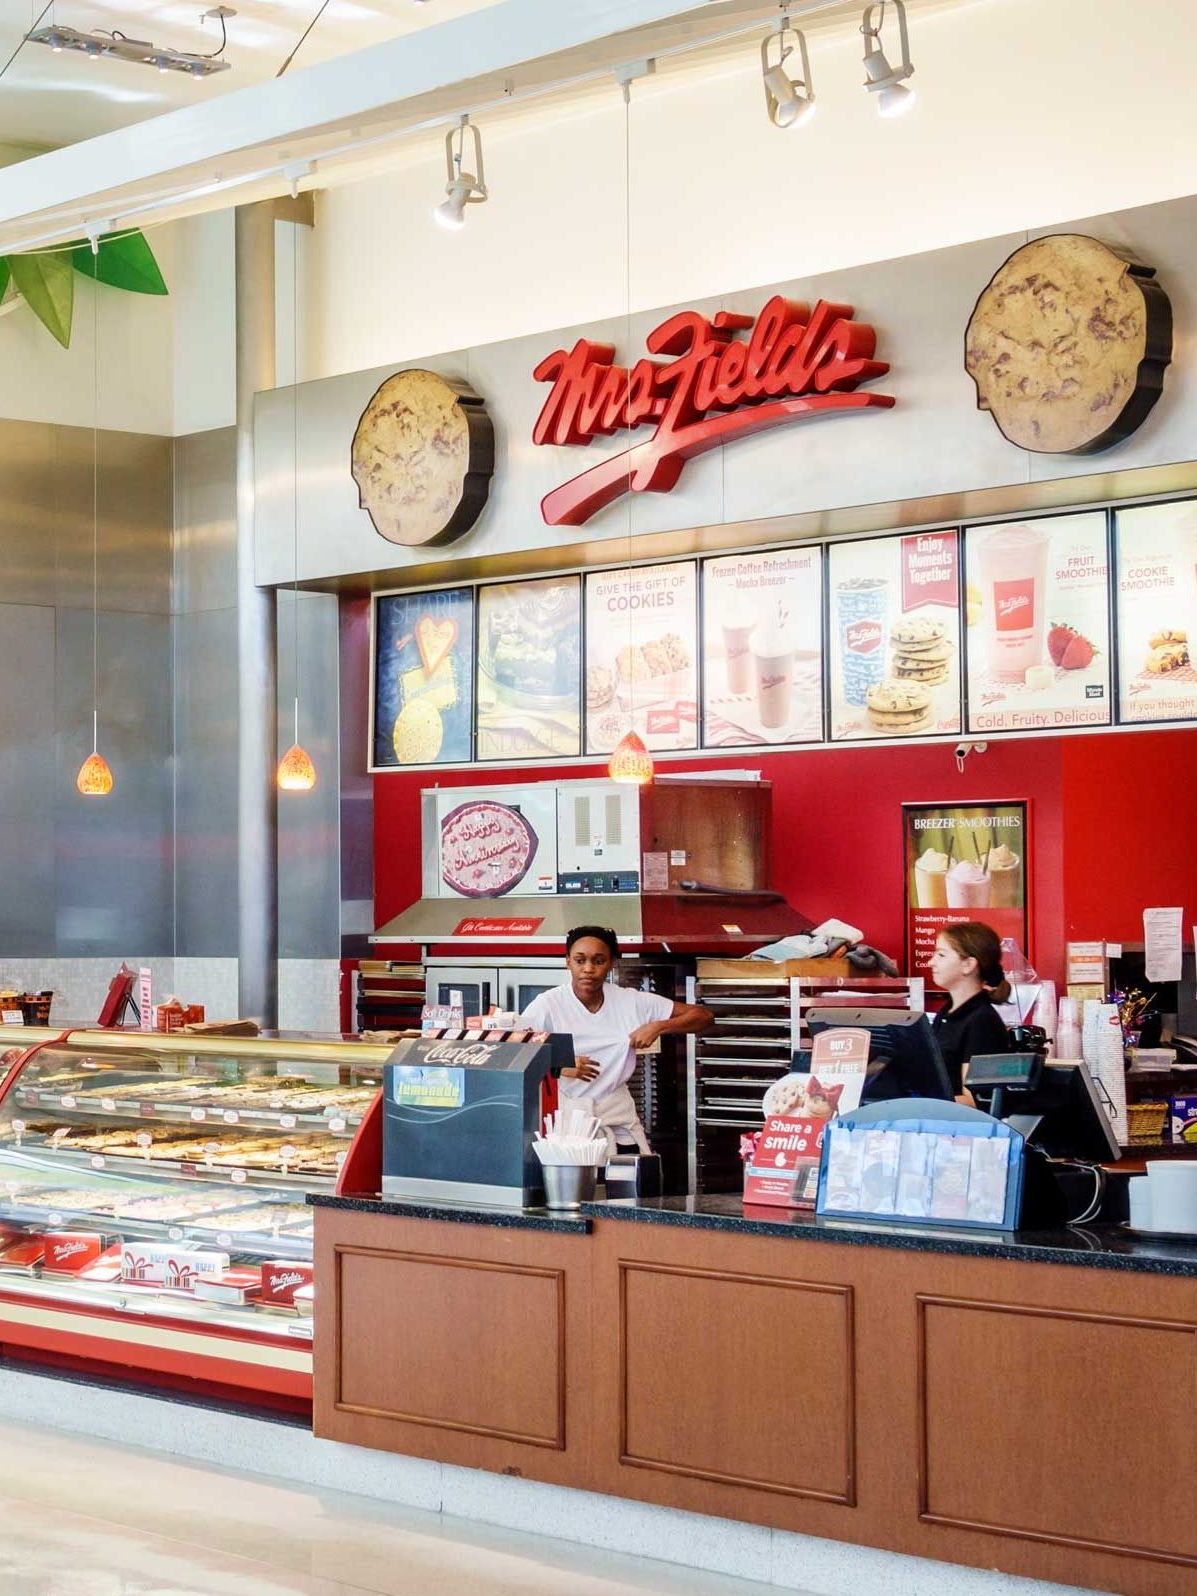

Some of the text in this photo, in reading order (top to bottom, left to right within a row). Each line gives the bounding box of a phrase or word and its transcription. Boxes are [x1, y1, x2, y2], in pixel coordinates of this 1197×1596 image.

[916, 536, 943, 554] Enjoy
[711, 555, 812, 578] Frozen Coffee Refreshment
[908, 552, 953, 569] Moments
[1067, 556, 1095, 567] FRUIT
[909, 567, 952, 585] Together
[1127, 565, 1169, 579] COOKIE
[596, 575, 686, 596] GIVE THE GIFT OF
[735, 577, 759, 589] Mocha
[1120, 576, 1175, 592] SMOOTHIE
[391, 590, 460, 625] SHARE
[607, 590, 675, 612] COOKIES
[1129, 698, 1195, 713] If you thought
[976, 714, 1007, 728] Cold.
[1011, 711, 1050, 728] Fruity.
[479, 727, 561, 753] INDULGE
[459, 819, 501, 840] Happy
[914, 815, 1021, 830] BREEZER SMOOTHIES
[915, 914, 970, 924] Strawberry-Banana
[915, 927, 936, 936] Mango
[915, 938, 935, 946] Mocha
[423, 1007, 463, 1019] Sof Drinks
[844, 1038, 853, 1051] 3
[423, 1043, 500, 1065] Coca-Cola
[769, 1119, 812, 1135] Share a
[764, 1135, 808, 1151] smile
